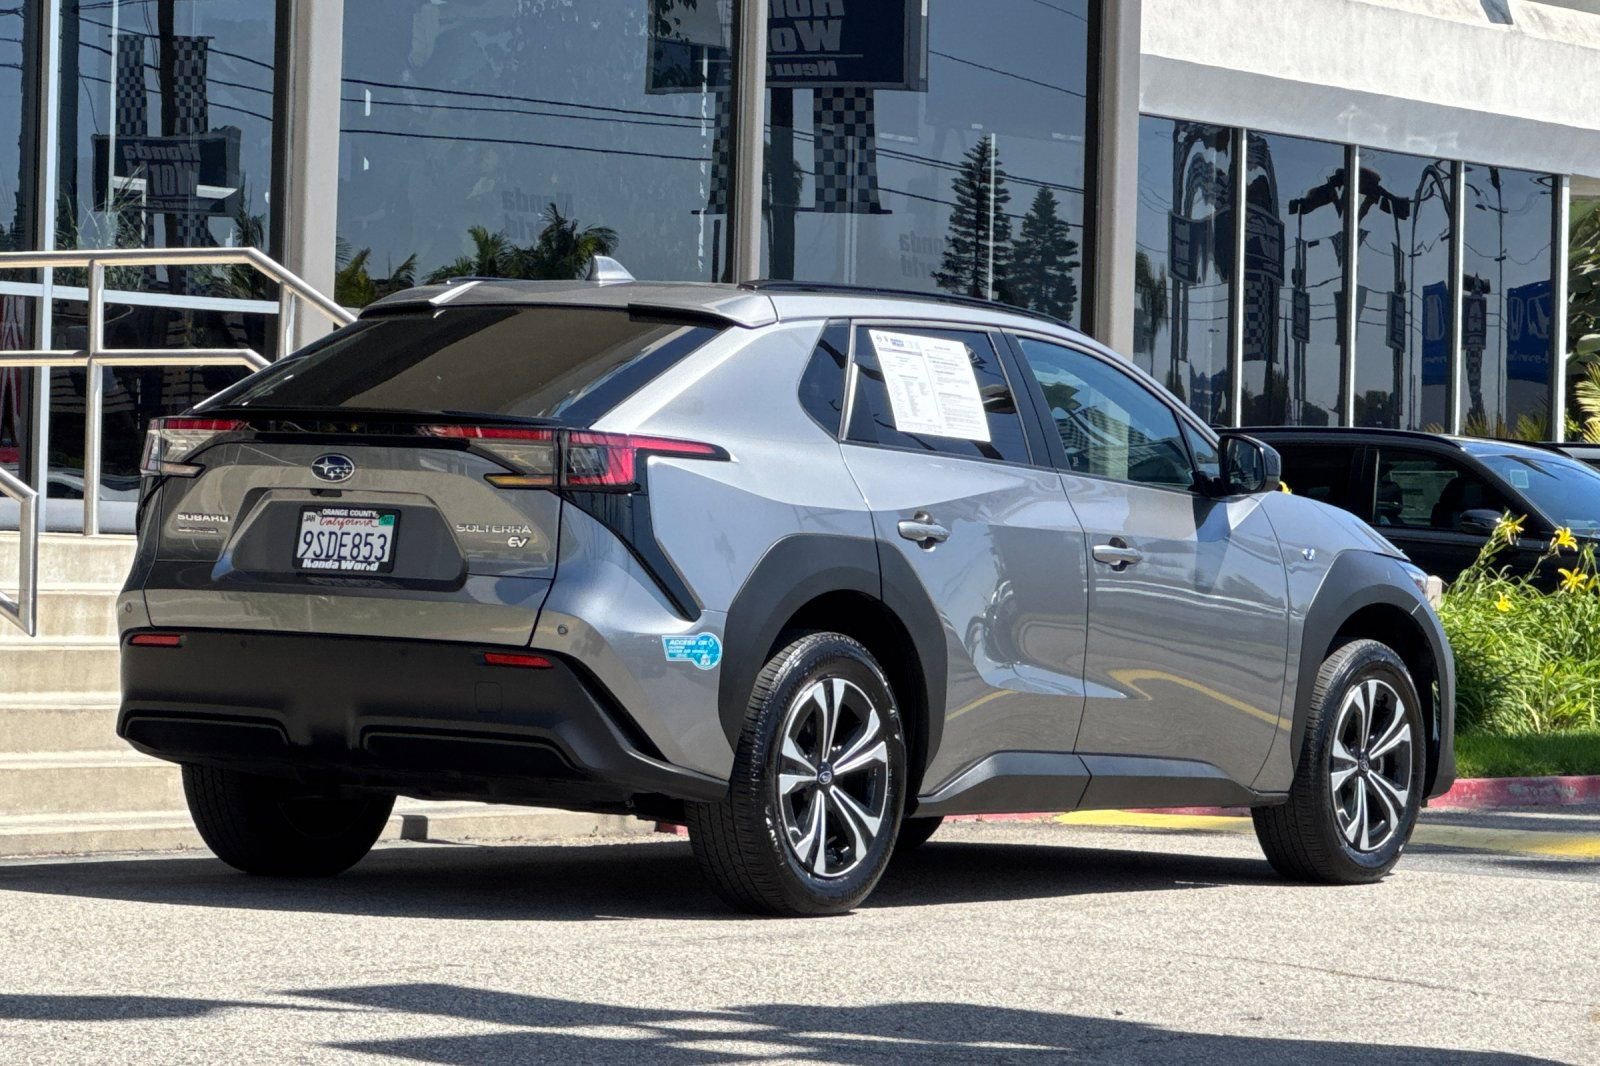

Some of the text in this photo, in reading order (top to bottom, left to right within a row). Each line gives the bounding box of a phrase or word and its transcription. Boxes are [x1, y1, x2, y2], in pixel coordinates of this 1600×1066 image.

[177, 513, 229, 522] SUBARU
[322, 508, 377, 517] ORANGE COUNTY
[319, 516, 379, 530] California
[456, 523, 532, 534] SOLTERRA
[300, 530, 388, 561] 9SDE853
[507, 536, 528, 548] EV
[302, 558, 380, 571] Honda World
